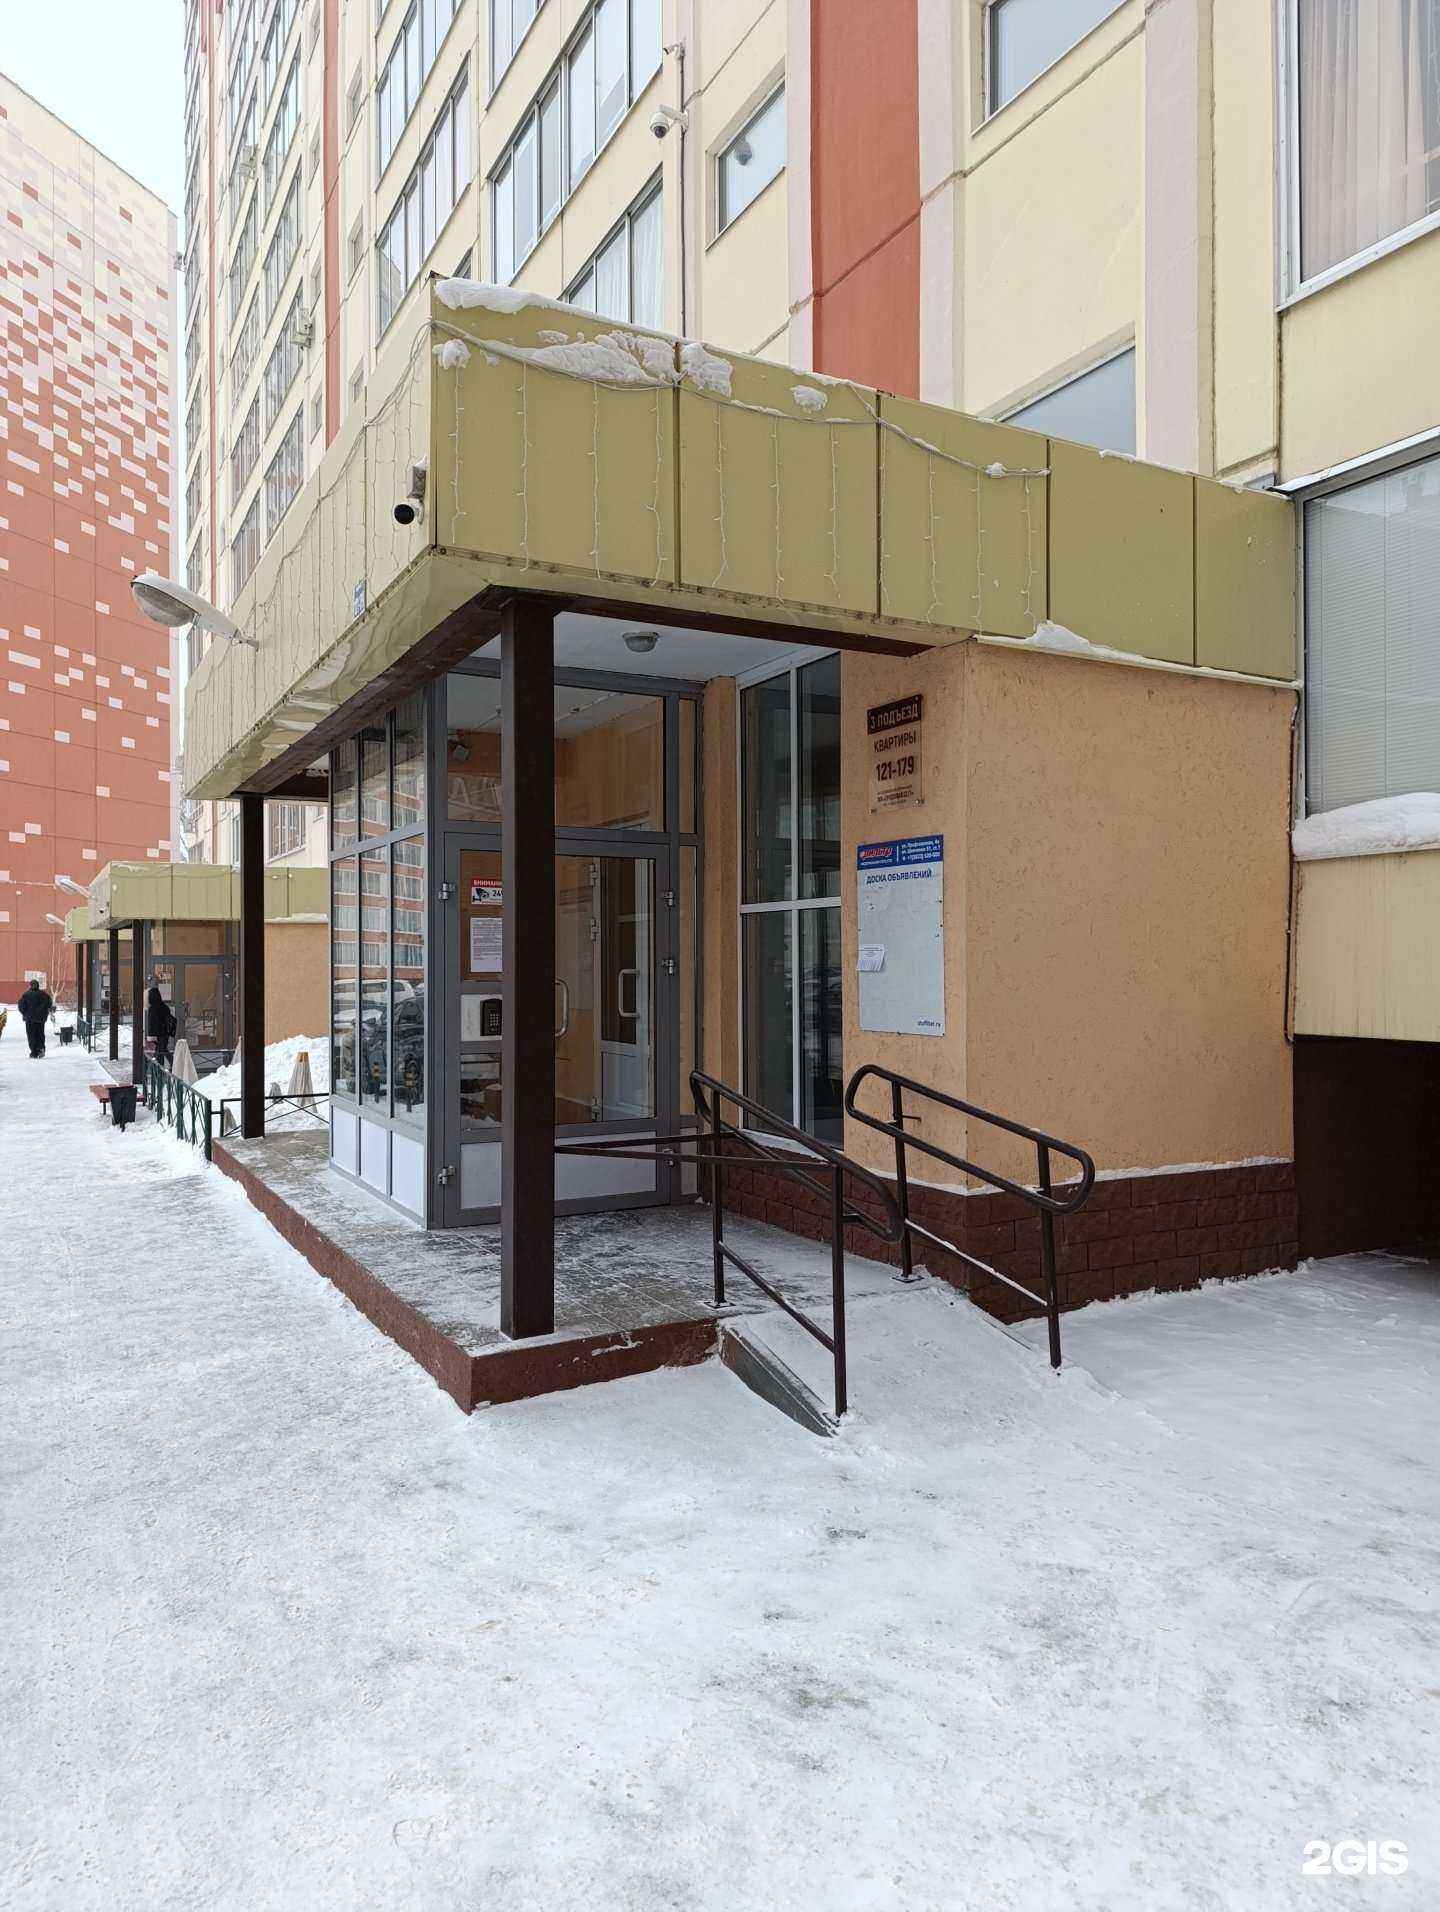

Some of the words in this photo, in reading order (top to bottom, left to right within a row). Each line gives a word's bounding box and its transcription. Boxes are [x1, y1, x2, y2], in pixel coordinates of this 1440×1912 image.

[870, 715, 876, 729] 3
[877, 703, 919, 727] ПОДЪЕЗД
[874, 730, 916, 752] КВАРТИРЫ
[876, 755, 914, 781] 121-179
[866, 874, 887, 885] ДОСКА
[887, 868, 932, 881] ОБЪЯВЛЕНИЙ
